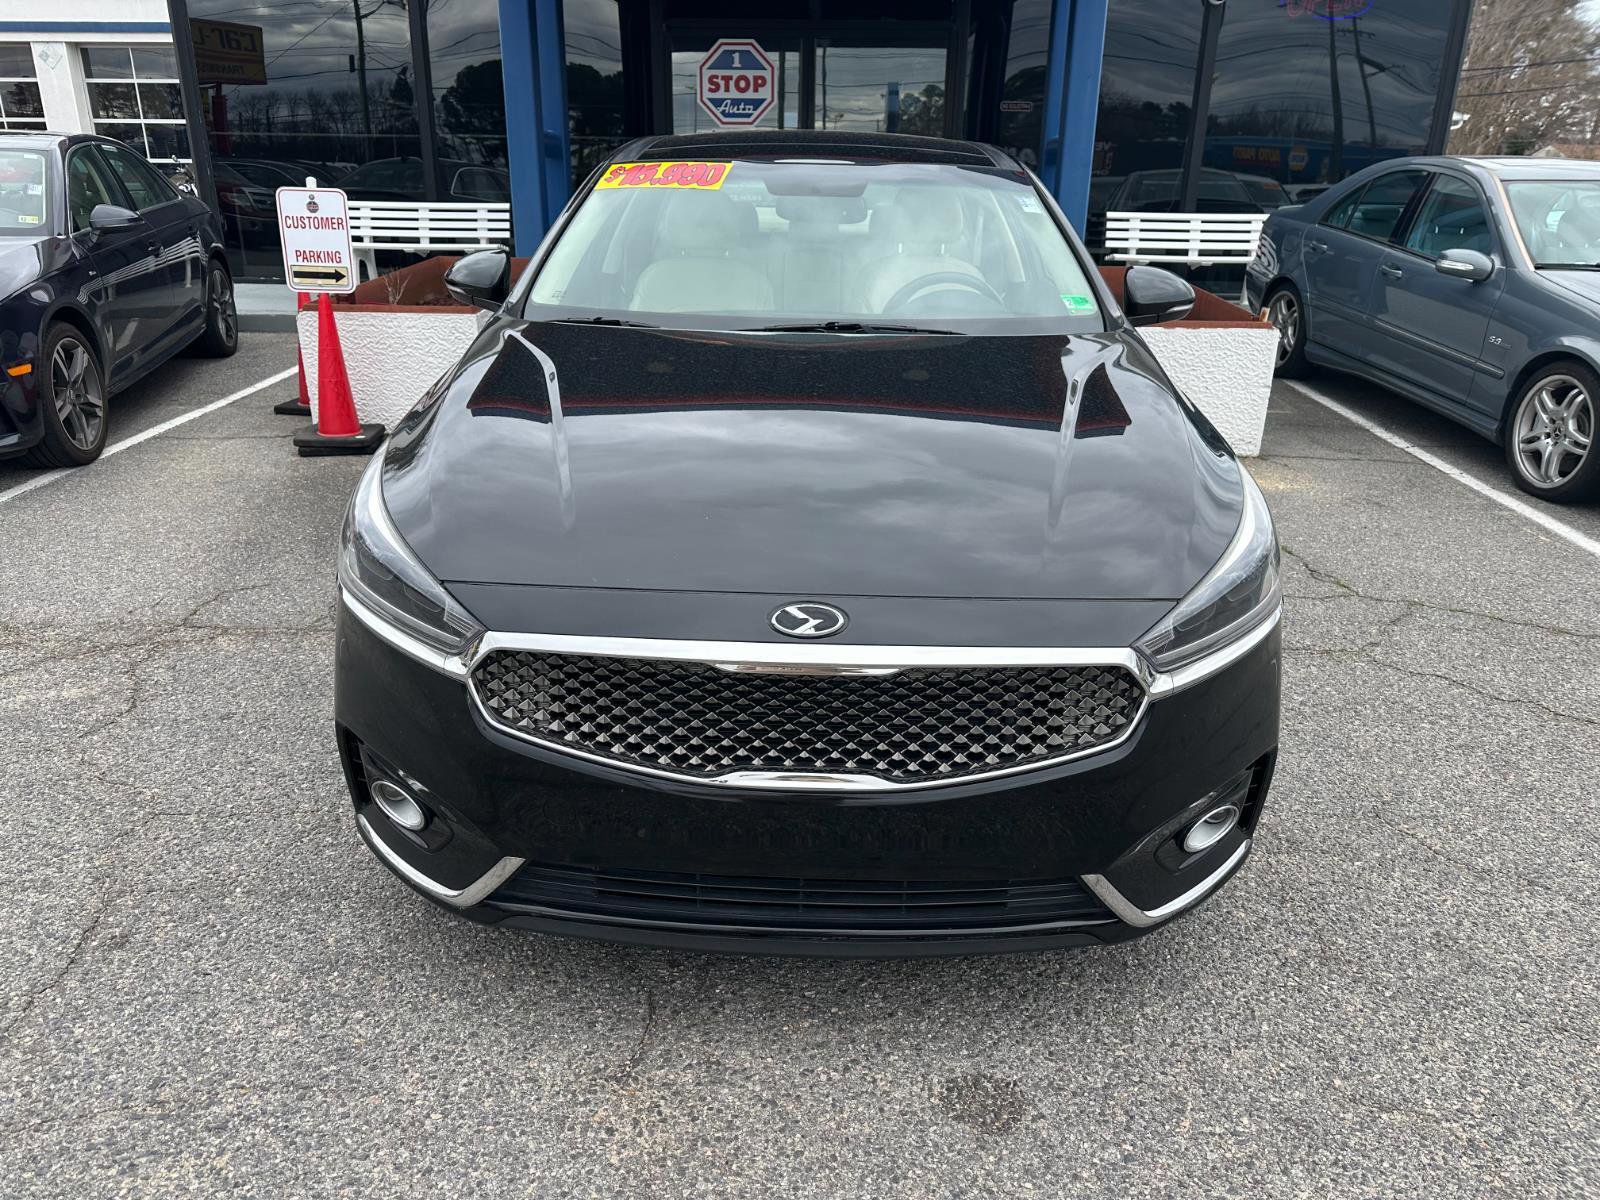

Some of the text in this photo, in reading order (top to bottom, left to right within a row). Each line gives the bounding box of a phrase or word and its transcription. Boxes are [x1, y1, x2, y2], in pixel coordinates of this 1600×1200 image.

[731, 52, 742, 67] 1
[707, 74, 767, 93] STOP
[717, 100, 757, 113] Auto
[284, 215, 345, 230] CUSTOMER
[295, 249, 342, 264] PARKING
